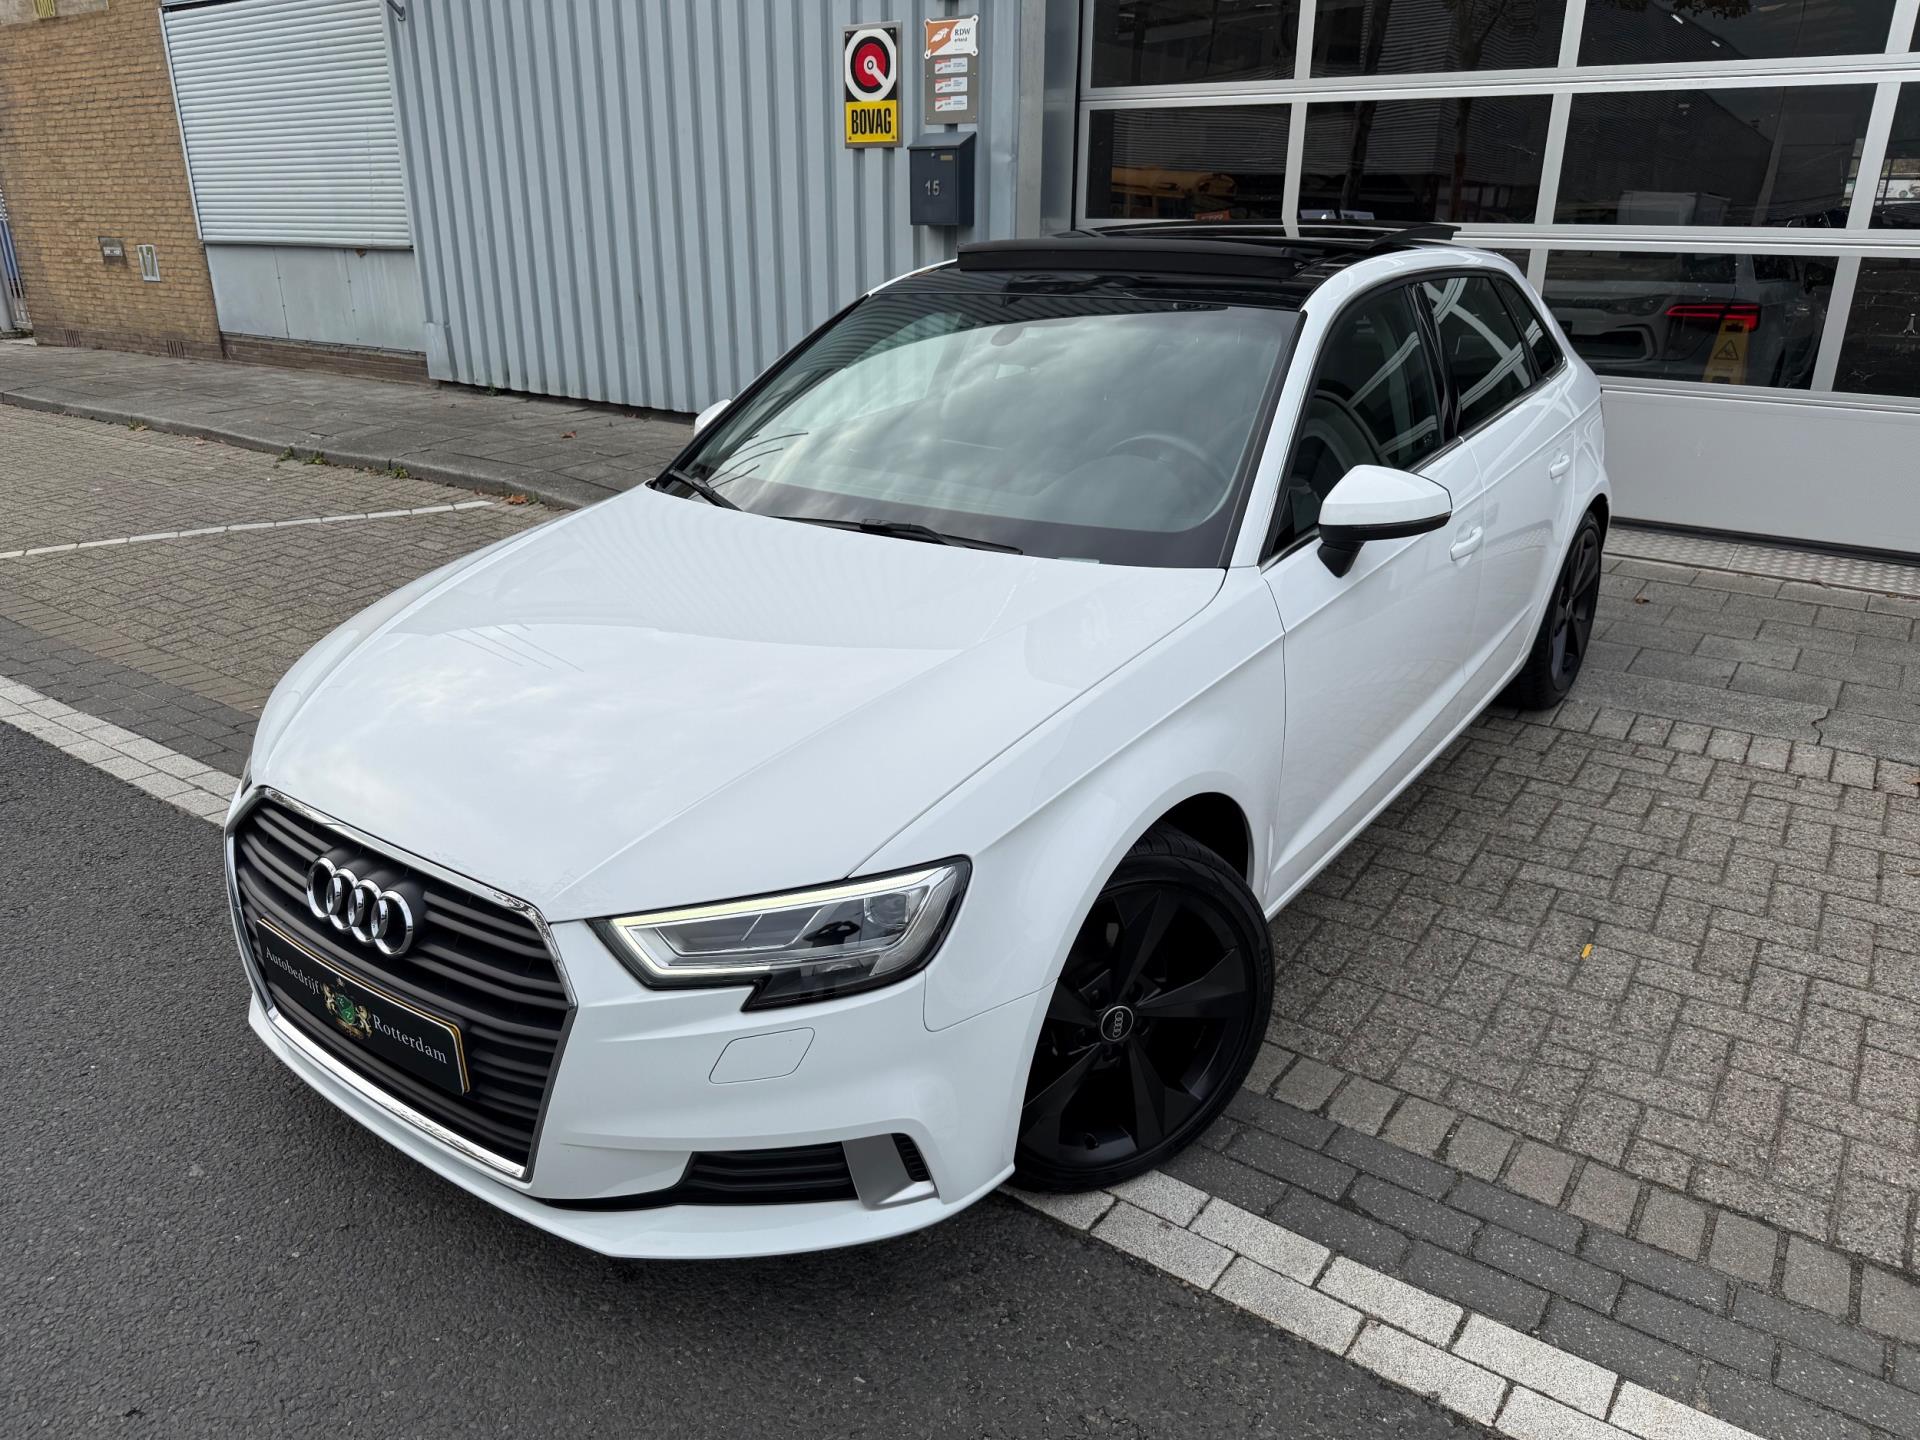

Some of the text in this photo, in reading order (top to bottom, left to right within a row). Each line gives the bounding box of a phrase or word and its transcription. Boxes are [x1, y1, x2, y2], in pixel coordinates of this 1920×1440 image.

[954, 28, 971, 36] RDW
[851, 108, 892, 135] BOVAG
[925, 180, 940, 195] 15
[138, 246, 155, 277] 17
[266, 946, 320, 995] Autobedrijf
[372, 1014, 448, 1064] Rotterdam
